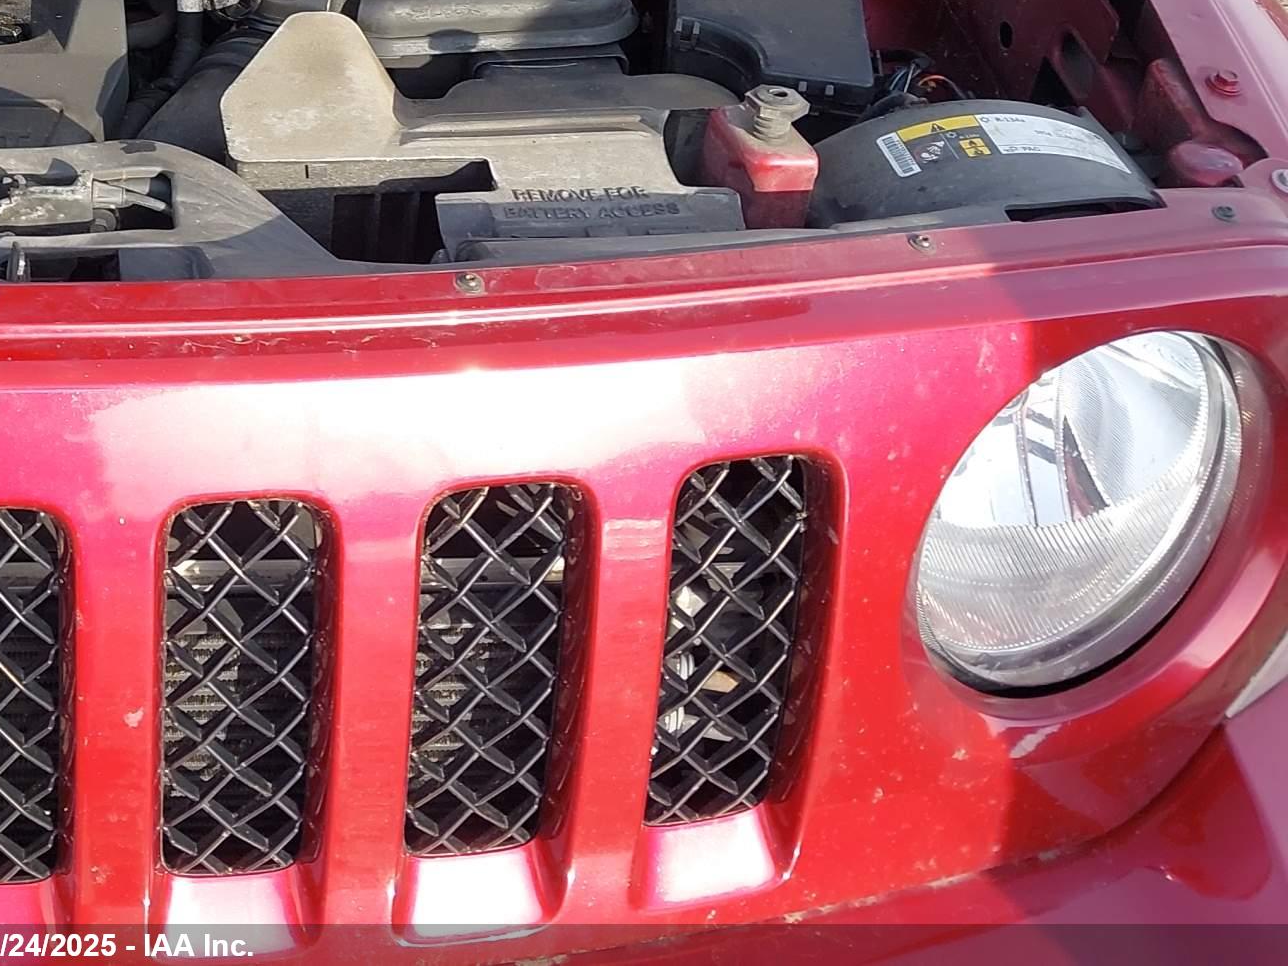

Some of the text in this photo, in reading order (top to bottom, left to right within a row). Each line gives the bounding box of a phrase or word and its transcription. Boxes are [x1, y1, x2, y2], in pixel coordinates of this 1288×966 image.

[511, 185, 650, 203] REMOVE FOR
[503, 202, 681, 220] BATTERY ACCESS
